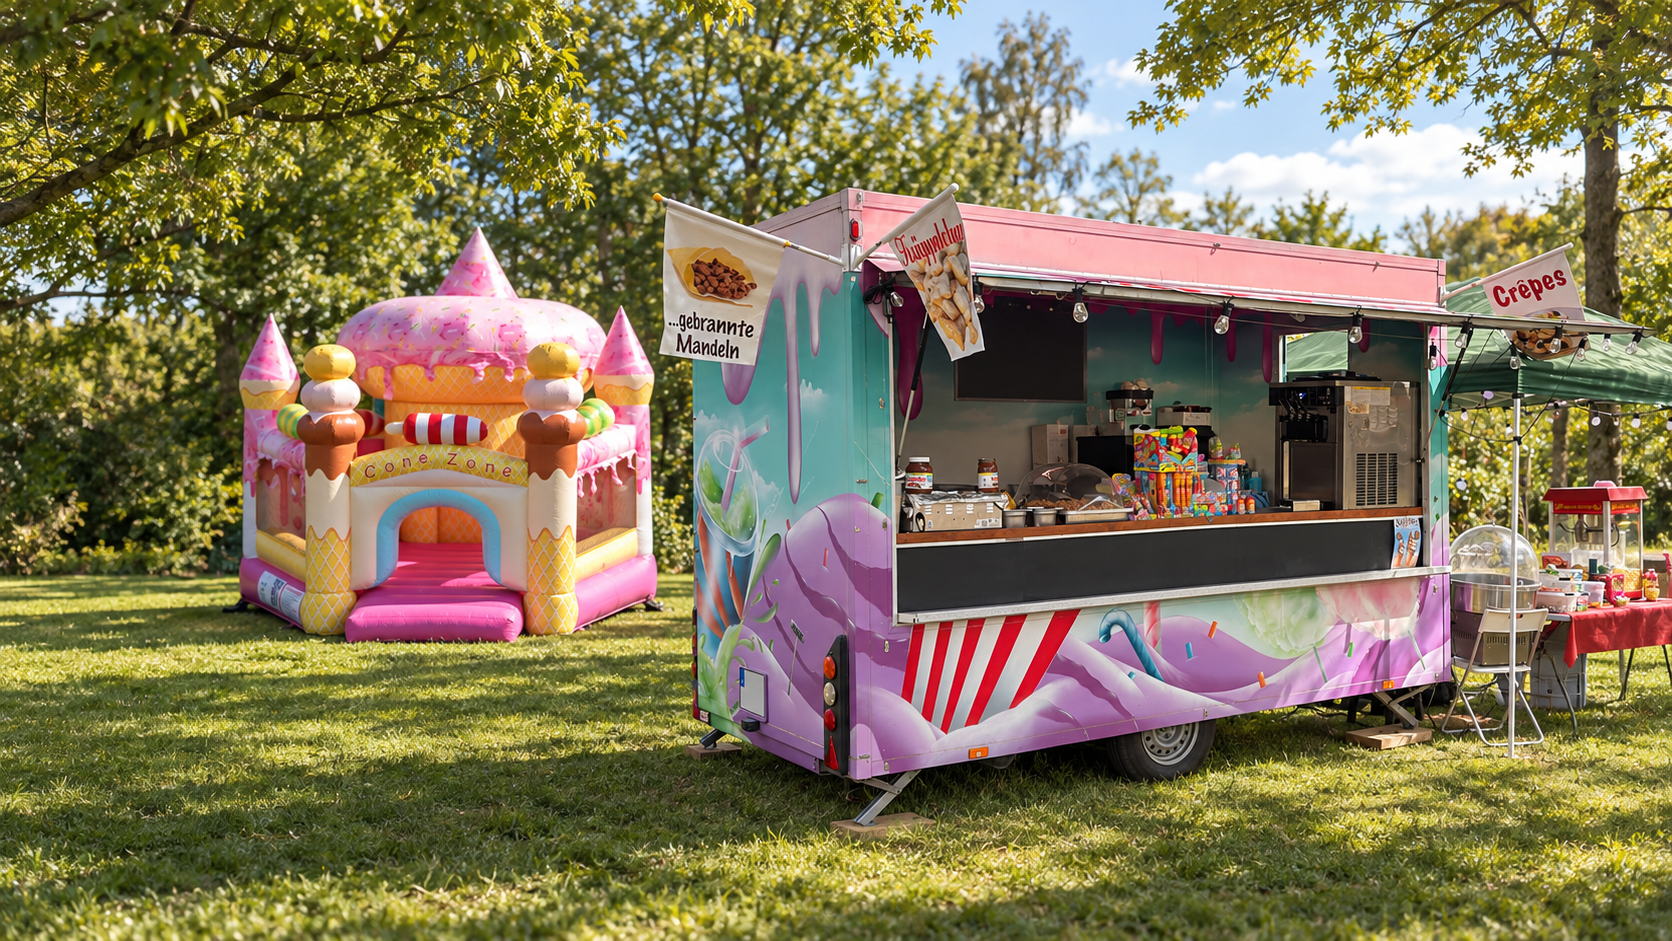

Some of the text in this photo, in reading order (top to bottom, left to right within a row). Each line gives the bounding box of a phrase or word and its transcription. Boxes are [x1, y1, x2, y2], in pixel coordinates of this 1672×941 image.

[1493, 269, 1567, 306] Crêpes
[676, 333, 739, 359] Mandeln
[364, 452, 512, 479] Cone Zone
